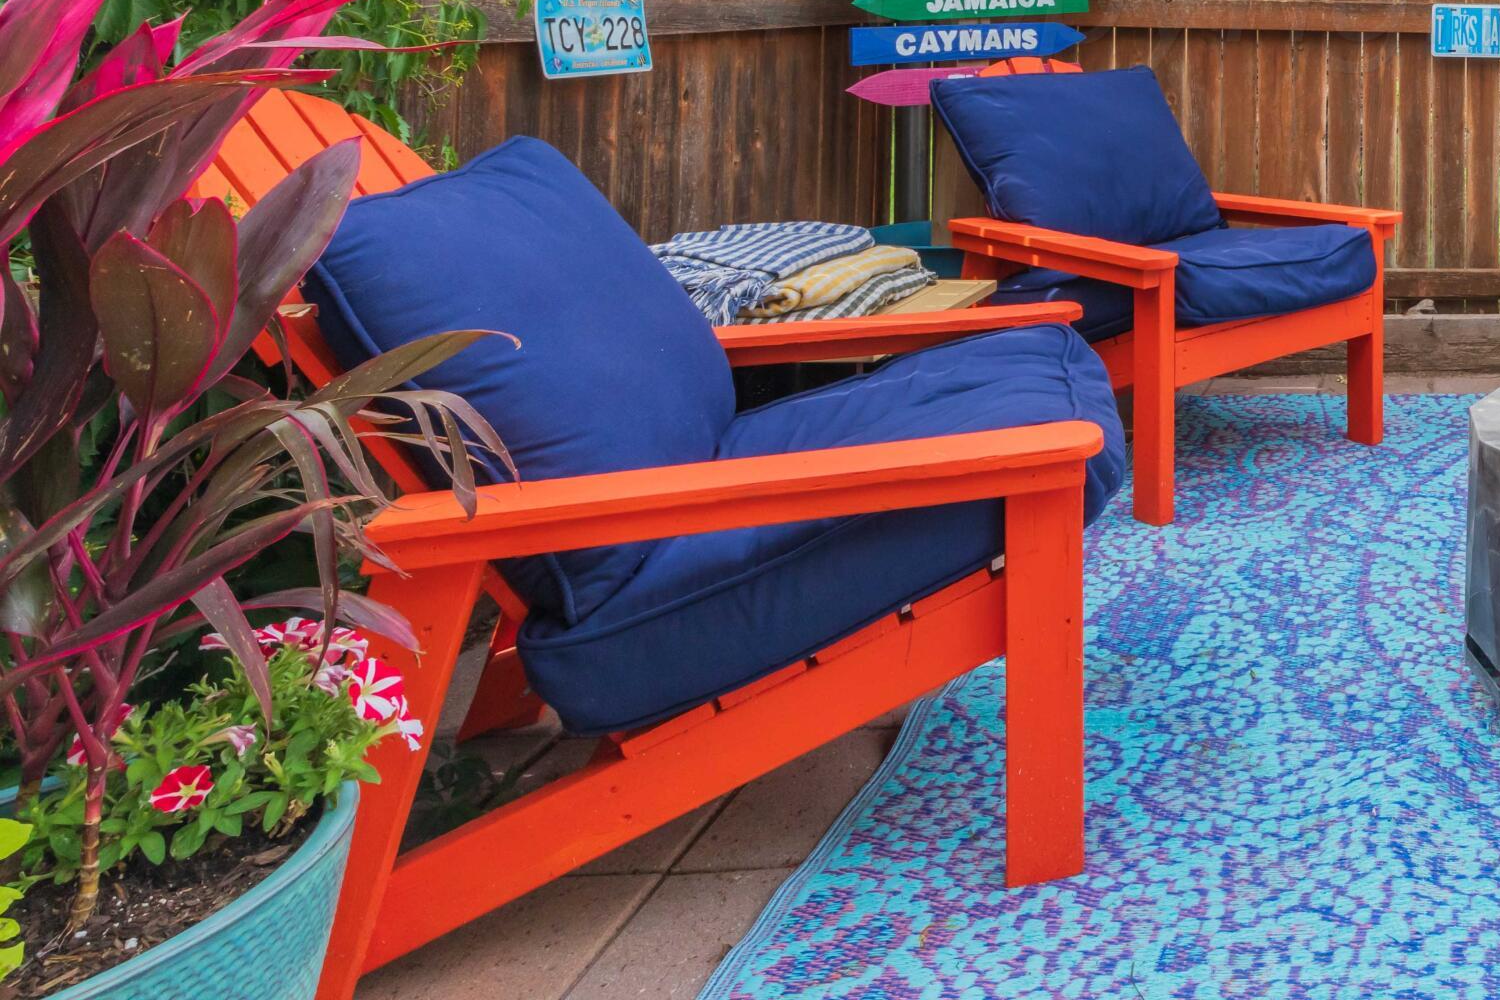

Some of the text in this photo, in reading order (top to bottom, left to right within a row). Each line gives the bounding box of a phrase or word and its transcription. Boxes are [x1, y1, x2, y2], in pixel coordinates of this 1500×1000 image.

[544, 17, 645, 53] TCY 228
[895, 28, 1038, 56] CAYMANS
